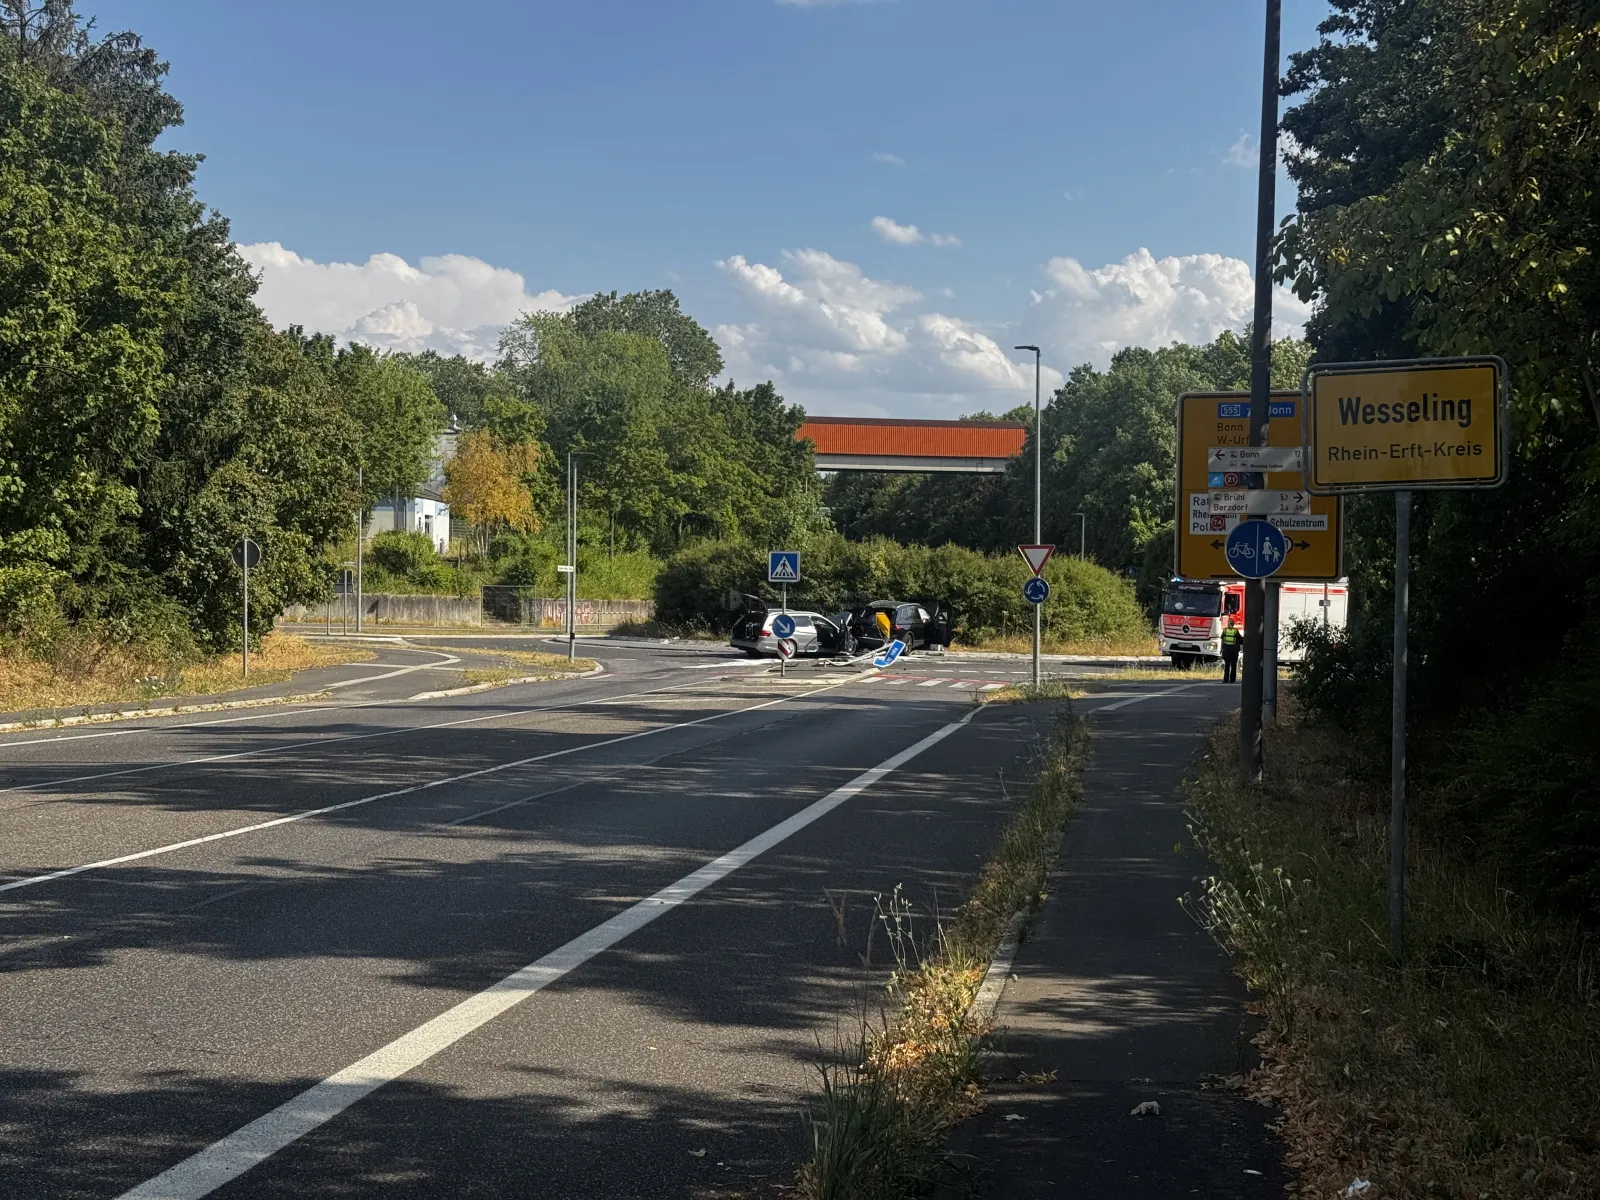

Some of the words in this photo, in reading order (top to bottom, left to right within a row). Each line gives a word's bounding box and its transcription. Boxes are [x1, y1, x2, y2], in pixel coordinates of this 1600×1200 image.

[1223, 406, 1239, 415] 555
[1338, 392, 1472, 428] Wesseling
[1217, 422, 1244, 432] Bonn
[1217, 435, 1251, 445] W.-Urf
[1239, 450, 1260, 459] Bonn
[1328, 441, 1483, 462] Rhein-Erft-Kreis
[1224, 493, 1245, 501] Brühl
[1213, 503, 1249, 511] Berzdorf
[1270, 517, 1325, 528] Schulzentrum
